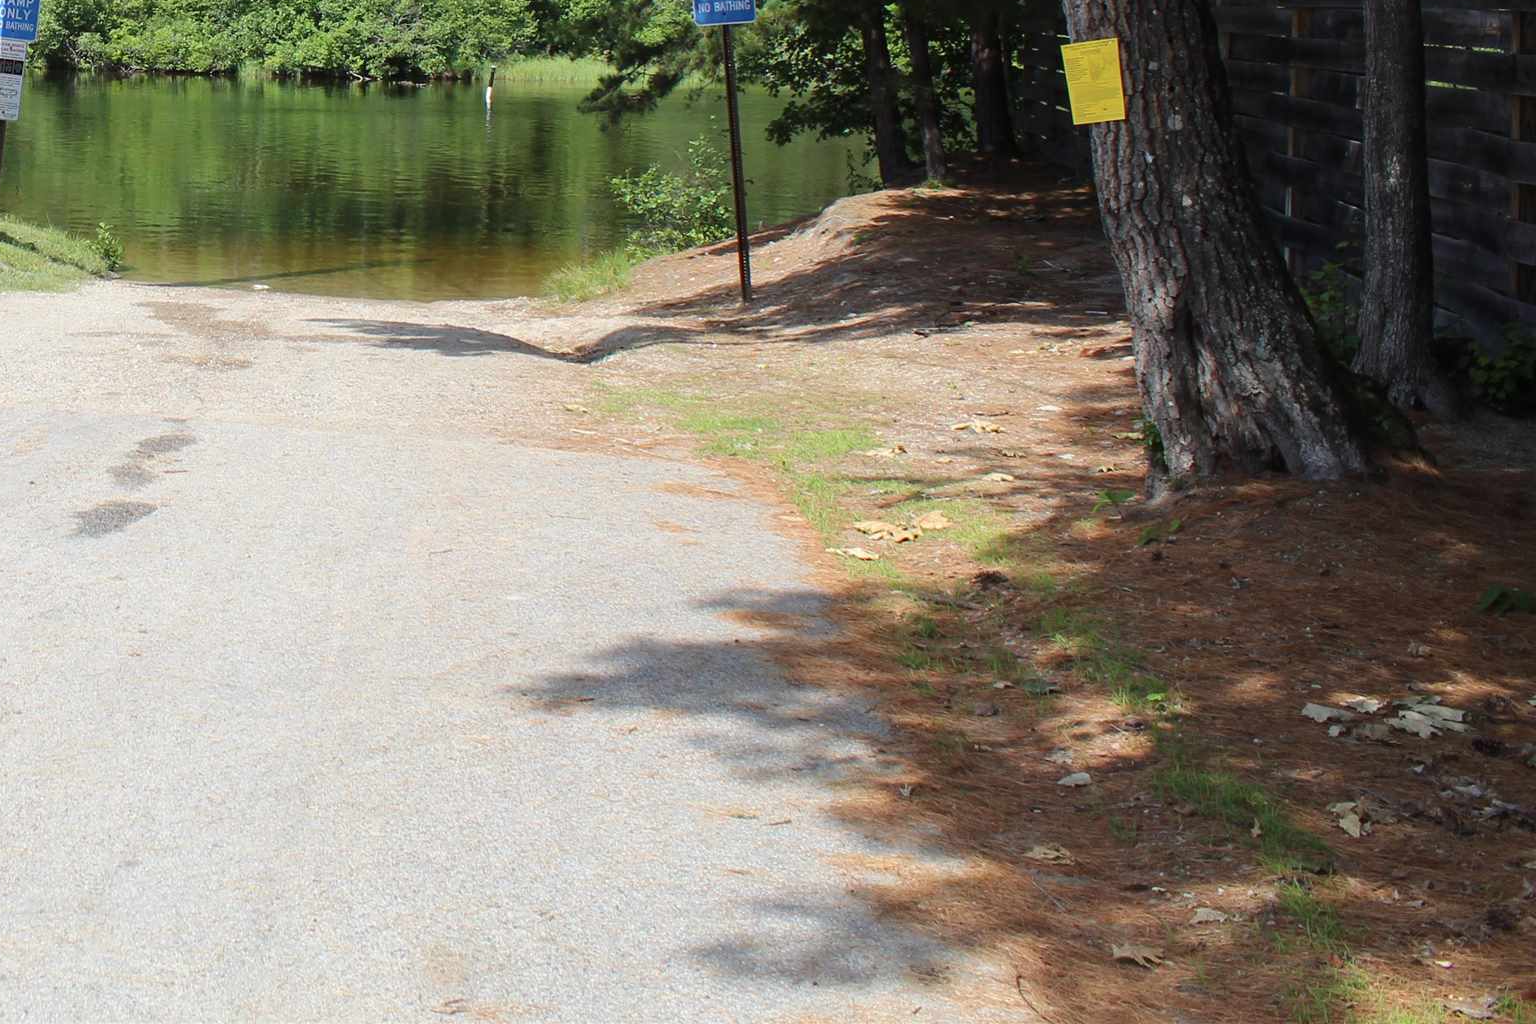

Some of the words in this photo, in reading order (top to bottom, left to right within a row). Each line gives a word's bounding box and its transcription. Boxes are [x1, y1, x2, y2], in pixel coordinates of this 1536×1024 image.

[0, 7, 31, 20] ONLY
[697, 3, 711, 14] NO
[714, 0, 751, 13] BATHING
[5, 21, 35, 32] BATHING
